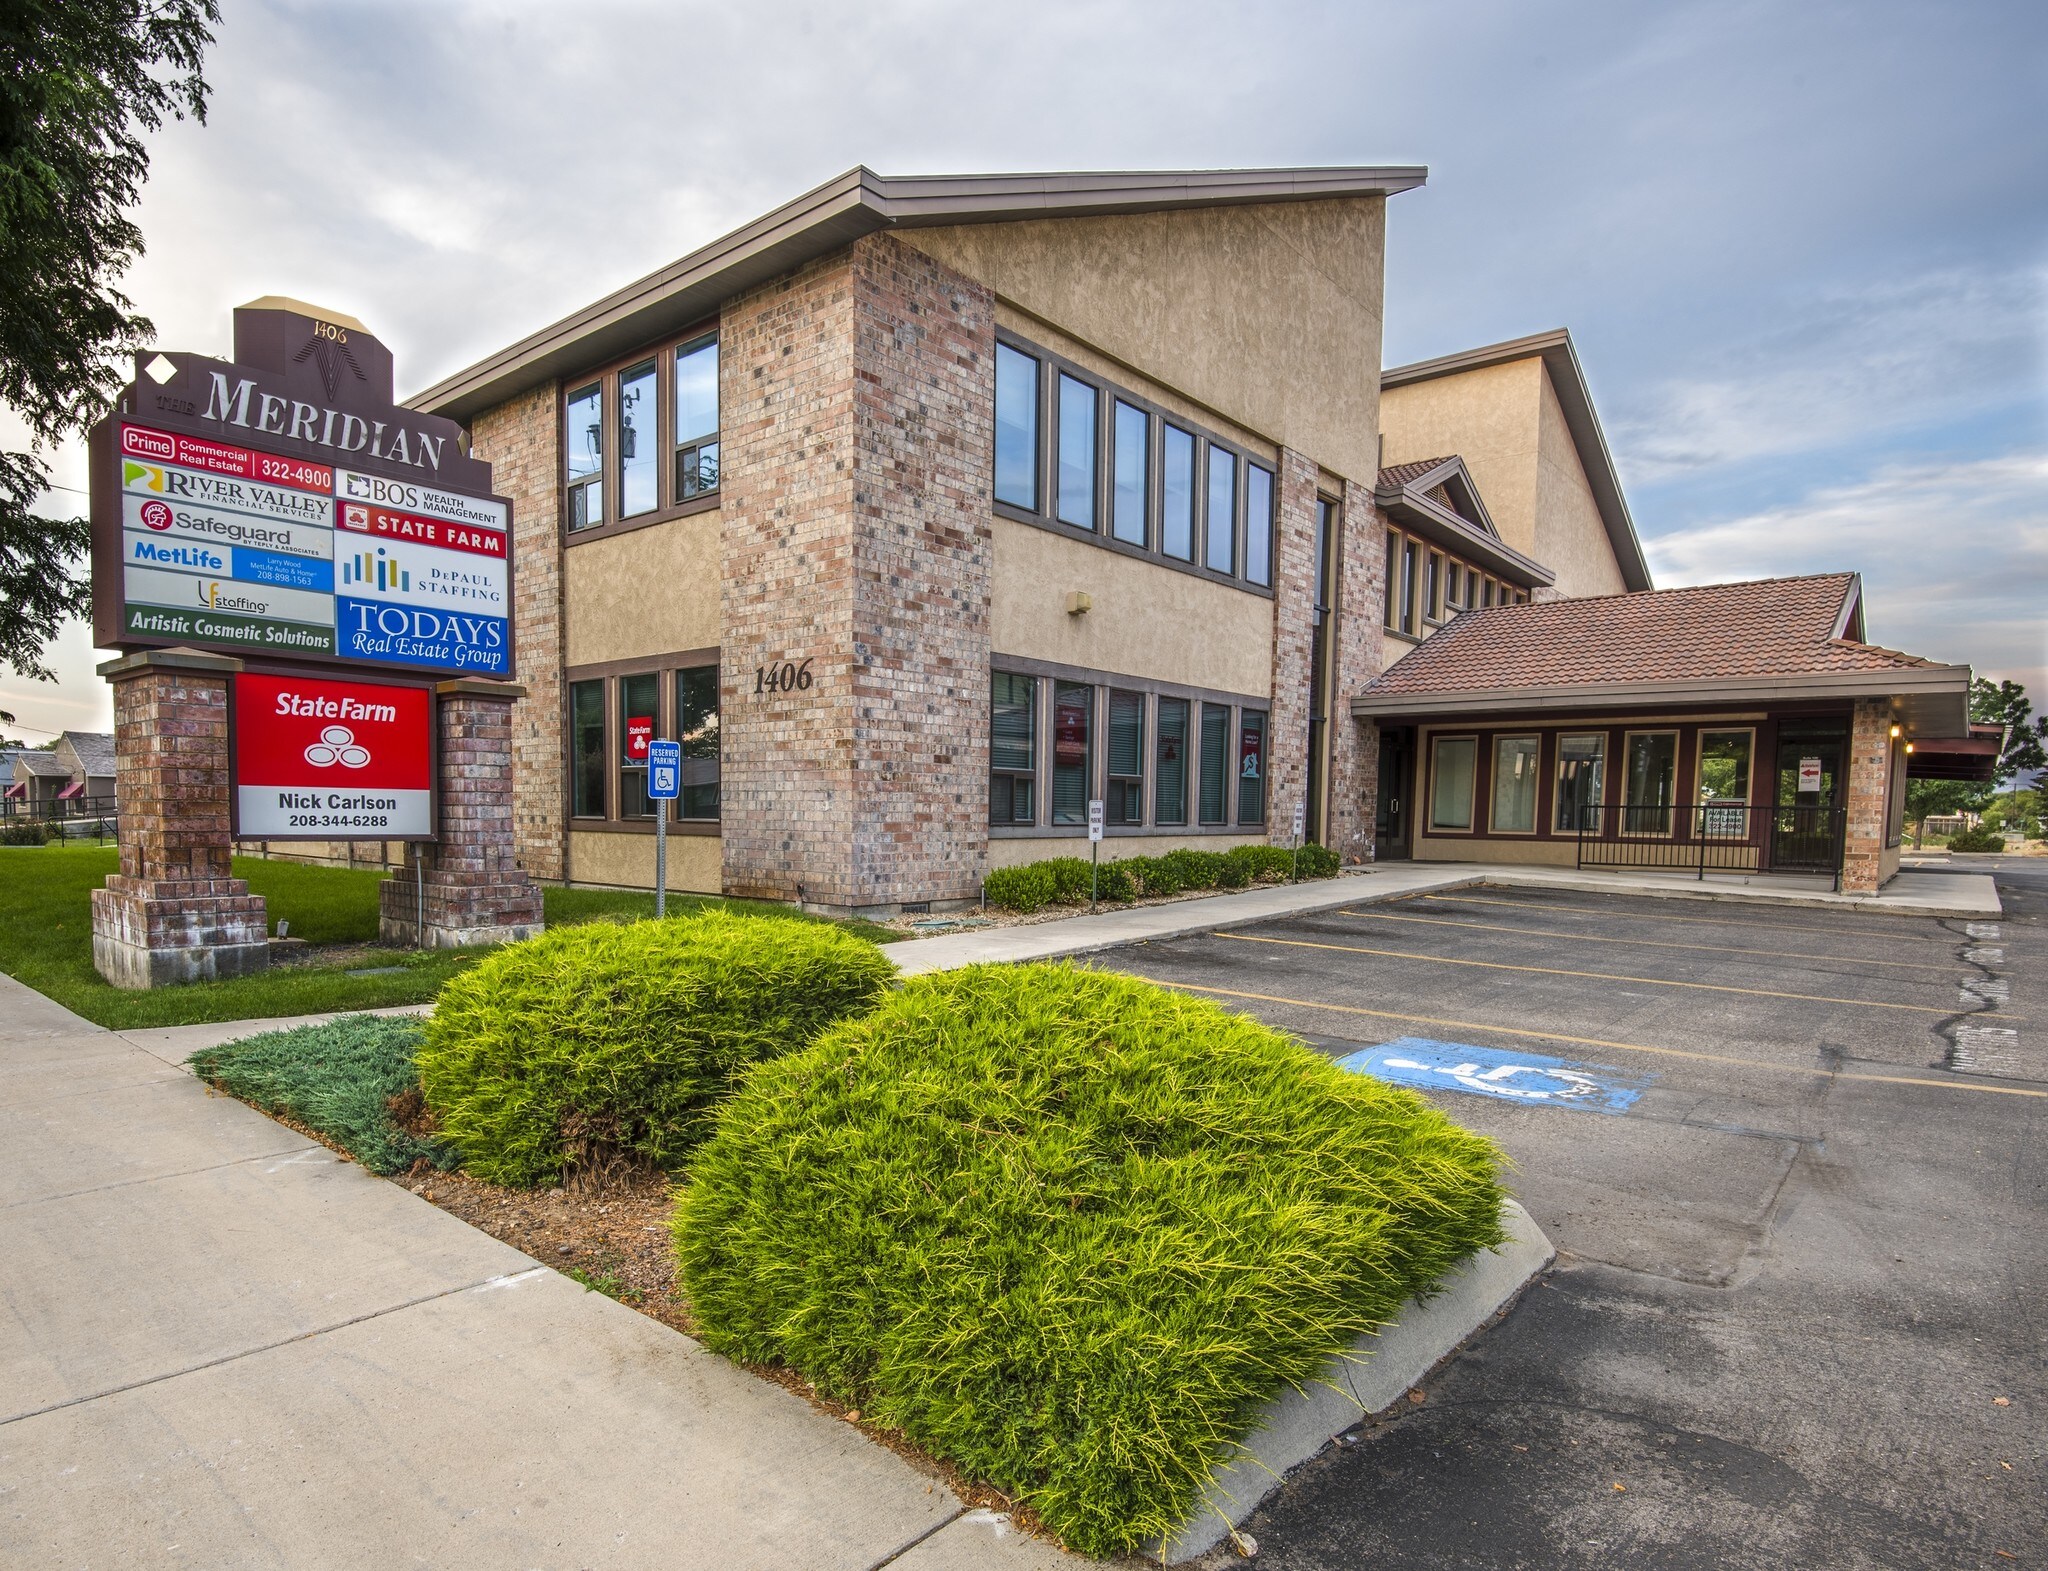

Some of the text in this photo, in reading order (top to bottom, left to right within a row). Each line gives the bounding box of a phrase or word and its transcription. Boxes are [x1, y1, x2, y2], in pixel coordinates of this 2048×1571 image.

[314, 320, 347, 344] 1406
[155, 371, 446, 471] THE MERIDIAN
[128, 433, 170, 454] Prime
[179, 440, 248, 462] Commercial
[179, 453, 244, 473] Real Estate
[262, 459, 331, 488] 322-4900
[165, 471, 330, 515] RIVER VALLEY
[373, 479, 418, 508] BOS
[423, 492, 464, 509] WEALTH
[200, 492, 322, 521] FINANCIAL SERVICES
[423, 501, 497, 524] MANAGEMENT
[175, 512, 292, 545] Safeguard
[377, 515, 499, 552] STATE FARM
[134, 541, 223, 569] MetLife
[254, 540, 273, 549] TEPLY
[280, 545, 320, 556] ASSOCIATES
[250, 562, 273, 571] MetLife
[274, 566, 289, 574] Auto
[267, 557, 301, 568] Larry Wood
[257, 571, 312, 586] 208-898-1563
[418, 581, 500, 602] STAFFING
[130, 611, 330, 648] Artistic Cosmetic Solutions
[350, 601, 501, 649] TODAYS
[352, 632, 501, 671] Real Estate Group
[754, 657, 815, 694] 1406
[651, 748, 679, 758] RESERVED
[653, 756, 676, 765] PARKING
[279, 793, 397, 810] Nick Carlson
[289, 815, 388, 827] 208-344-6288
